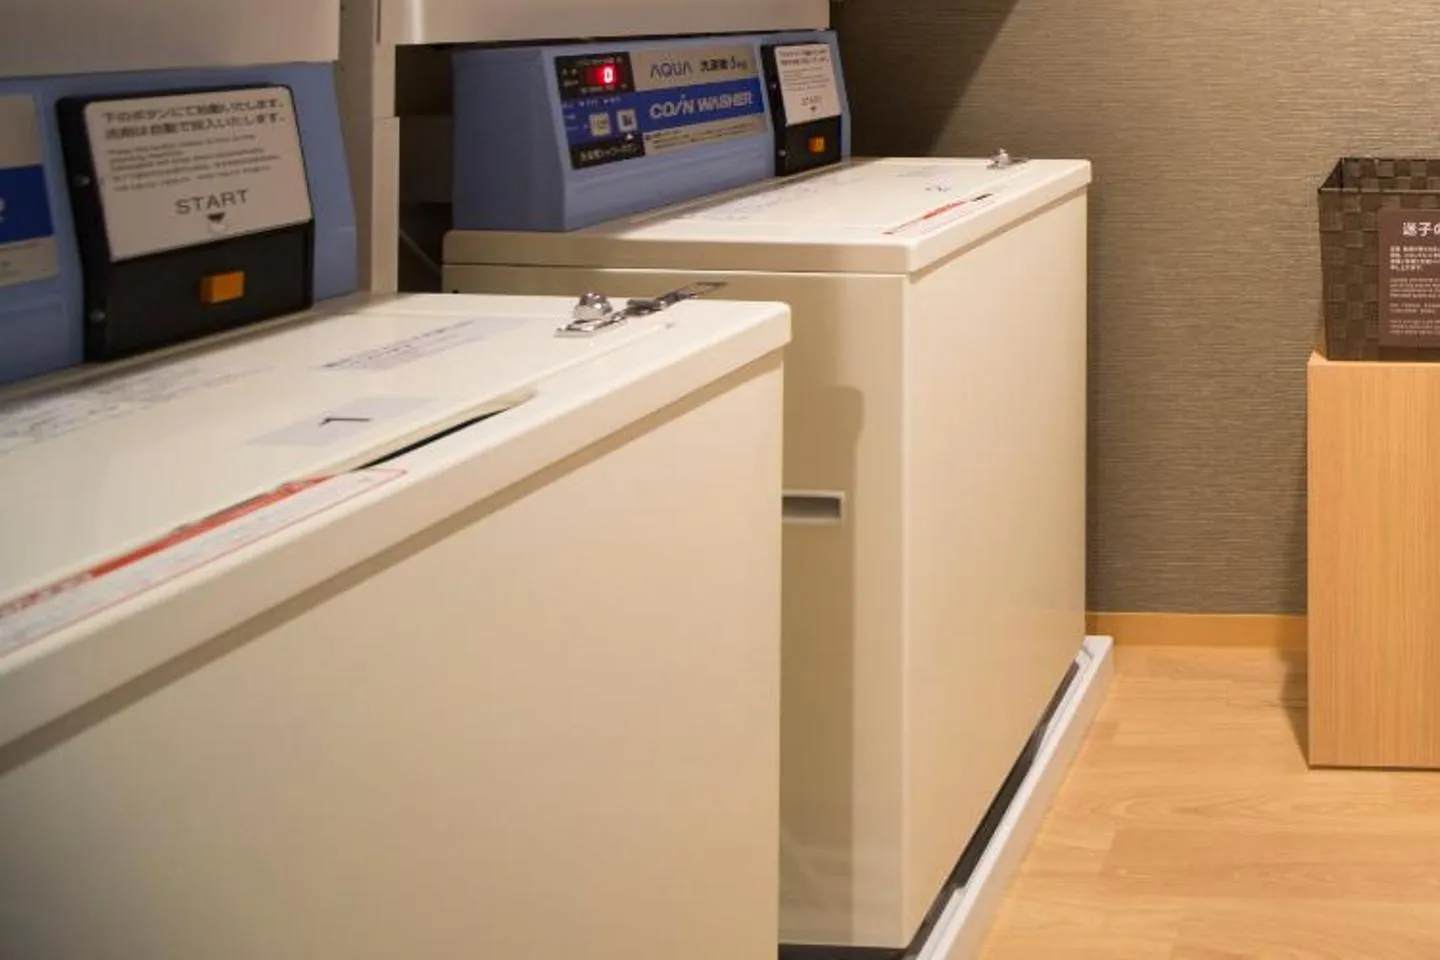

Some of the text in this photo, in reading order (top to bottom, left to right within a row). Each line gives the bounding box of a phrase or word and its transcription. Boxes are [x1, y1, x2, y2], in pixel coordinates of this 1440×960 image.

[603, 67, 614, 83] 0
[650, 61, 694, 79] AQUA
[696, 90, 754, 112] WASHER
[174, 188, 250, 216] START
